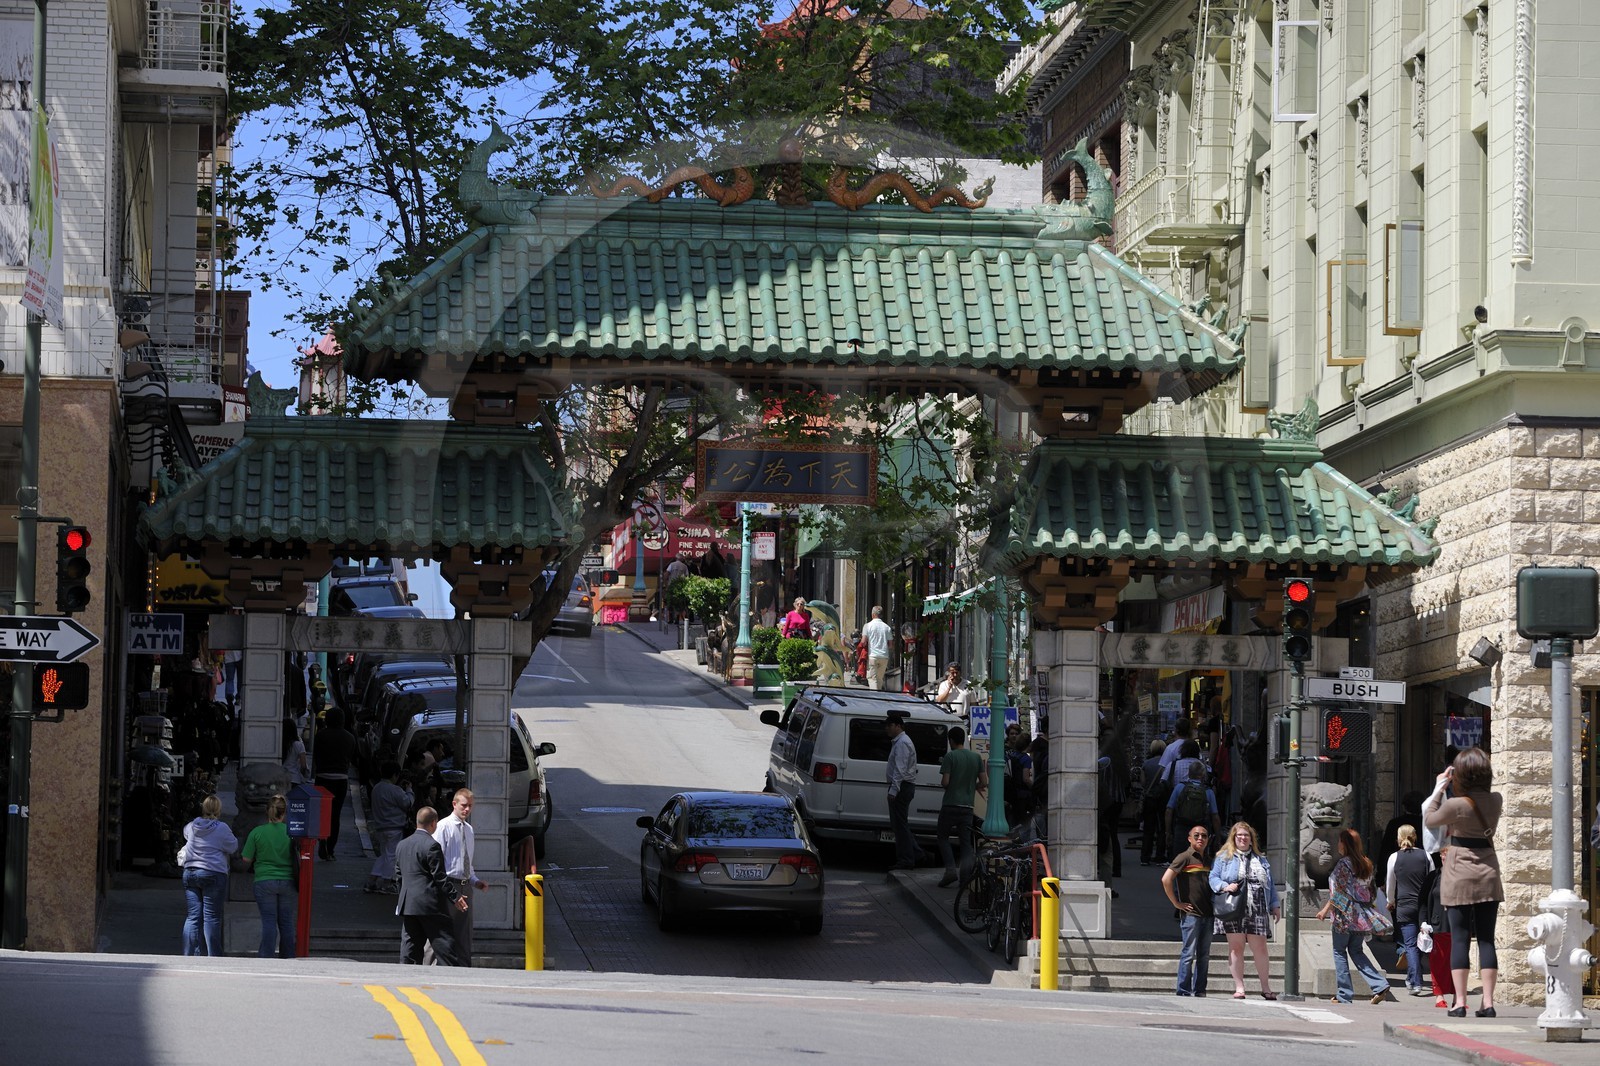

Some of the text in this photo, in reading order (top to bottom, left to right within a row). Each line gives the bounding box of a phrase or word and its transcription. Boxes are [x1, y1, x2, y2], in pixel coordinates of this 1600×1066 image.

[193, 435, 235, 447] CAMERAS
[16, 631, 51, 647] WAY
[132, 634, 180, 650] ATM
[1352, 669, 1370, 678] 500
[1333, 683, 1378, 697] BUSH
